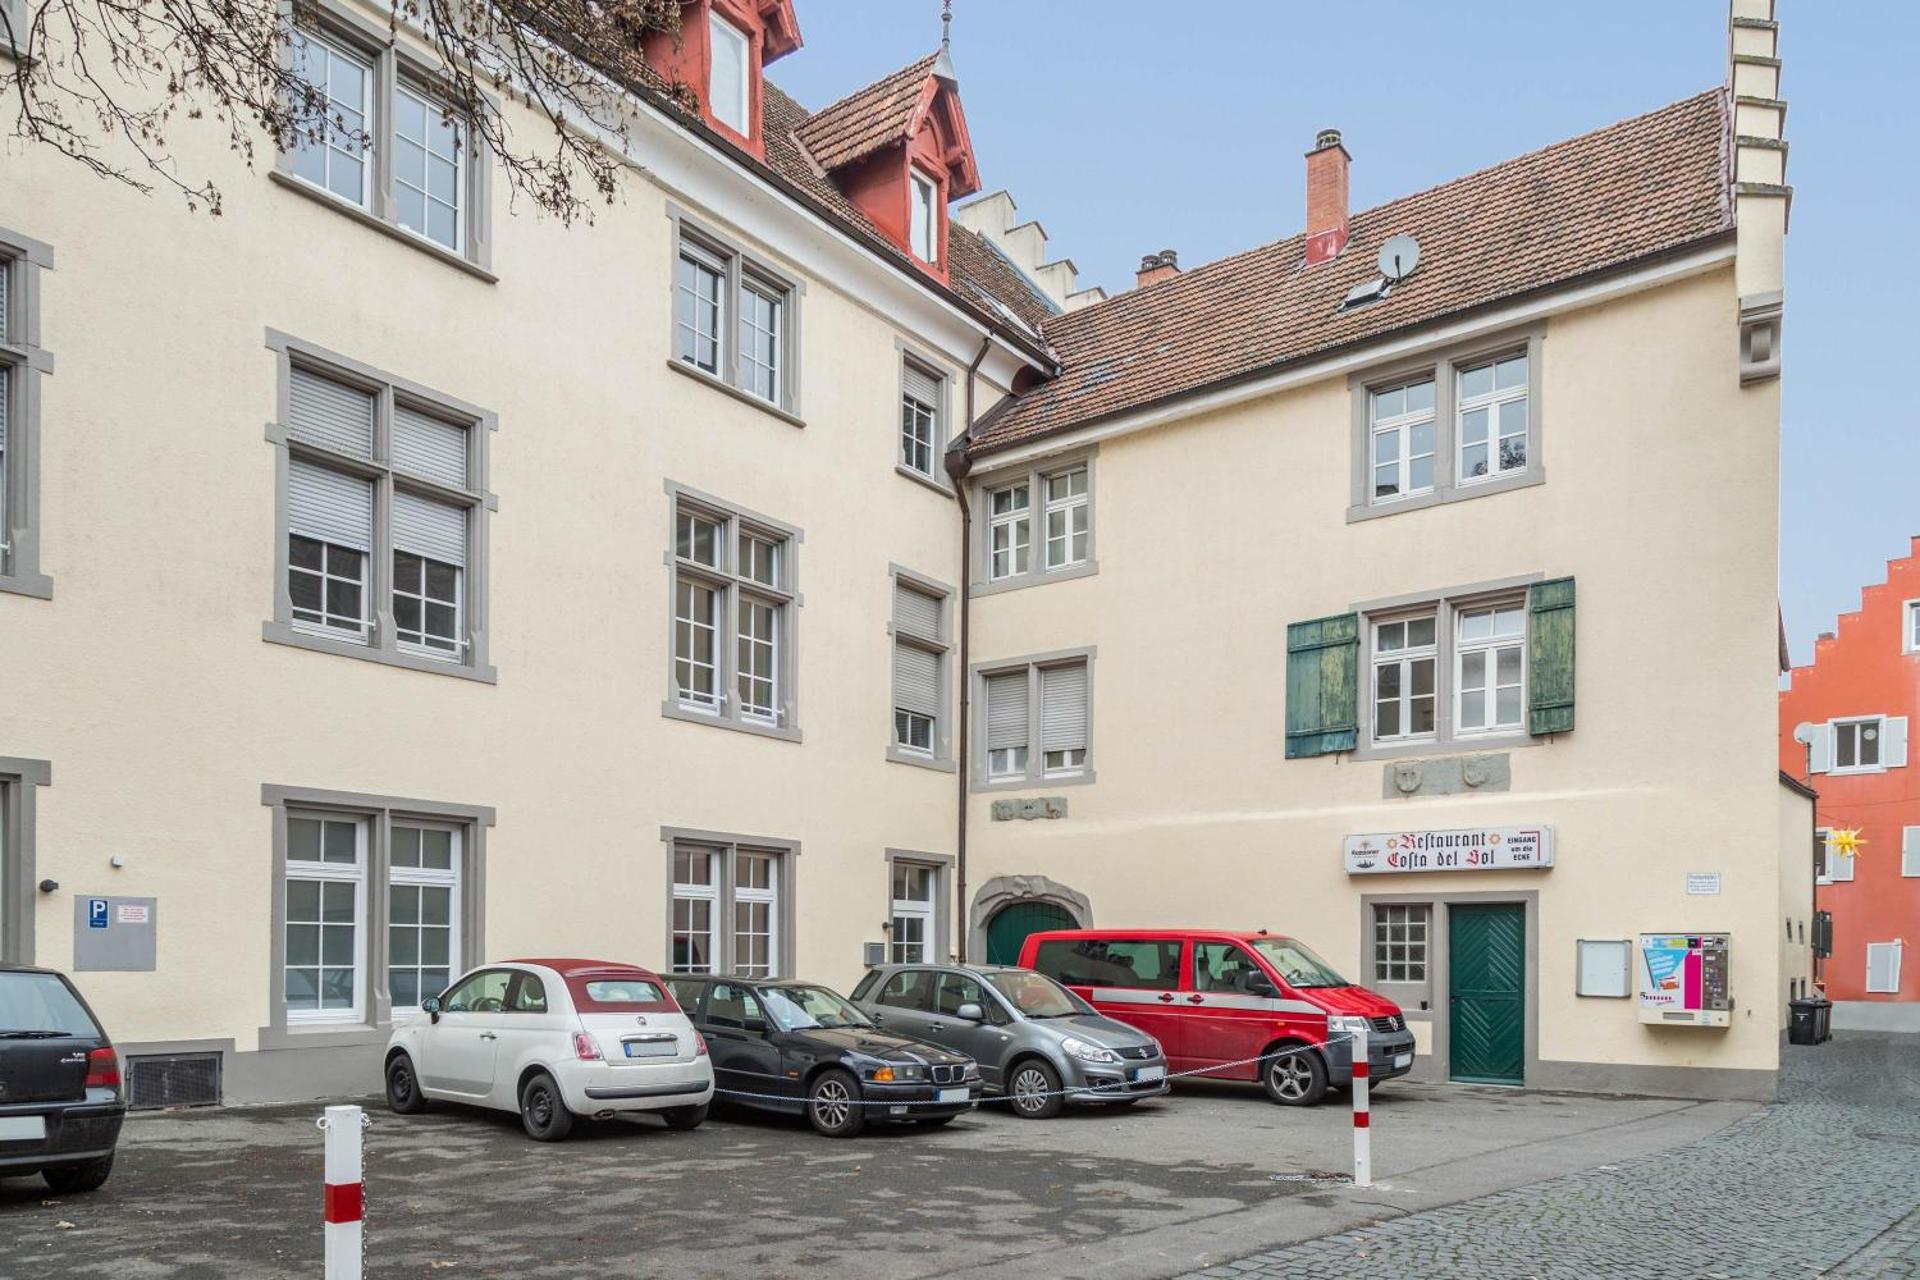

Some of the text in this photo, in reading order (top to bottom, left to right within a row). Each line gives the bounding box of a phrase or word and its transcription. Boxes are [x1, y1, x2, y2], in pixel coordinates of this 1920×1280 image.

[1400, 832, 1486, 851] Restaurant
[1507, 836, 1537, 844] EINGANG
[1387, 851, 1427, 869] Costa
[1437, 850, 1458, 866] del
[1513, 853, 1531, 861] ECKE
[93, 901, 106, 919] P
